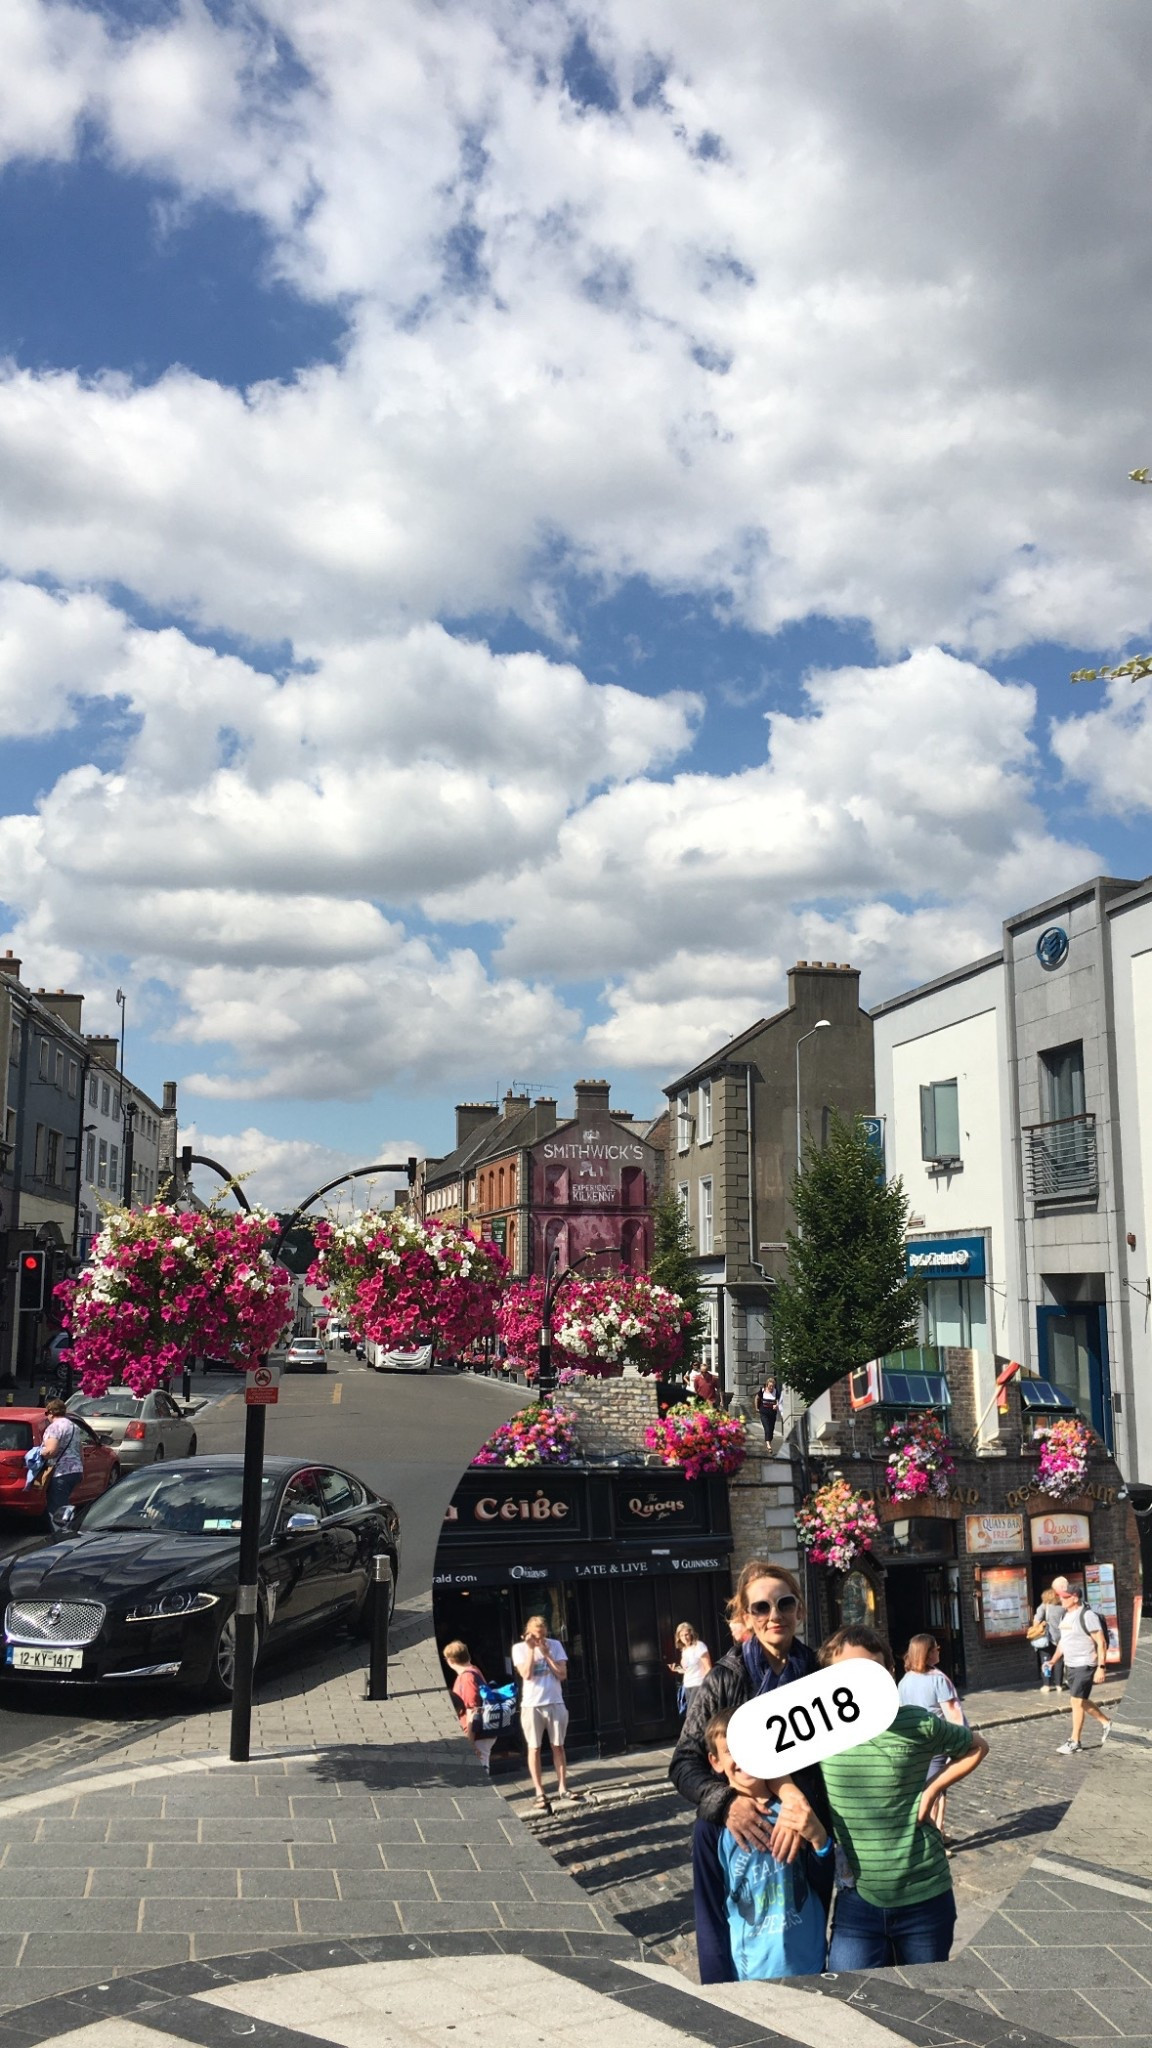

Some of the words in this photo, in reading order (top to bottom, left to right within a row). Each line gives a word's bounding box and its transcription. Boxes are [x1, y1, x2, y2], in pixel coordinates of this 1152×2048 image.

[543, 1144, 644, 1160] SMITHWICK'S
[572, 1184, 616, 1192] EXPERIENCE
[572, 1191, 616, 1202] KILKENNY
[628, 1498, 685, 1518] Quays
[1043, 1518, 1078, 1538] Quays
[575, 1564, 607, 1576] LATE
[609, 1563, 619, 1574] &
[621, 1562, 648, 1573] LIVE
[19, 1651, 74, 1668] 12-KY-1417
